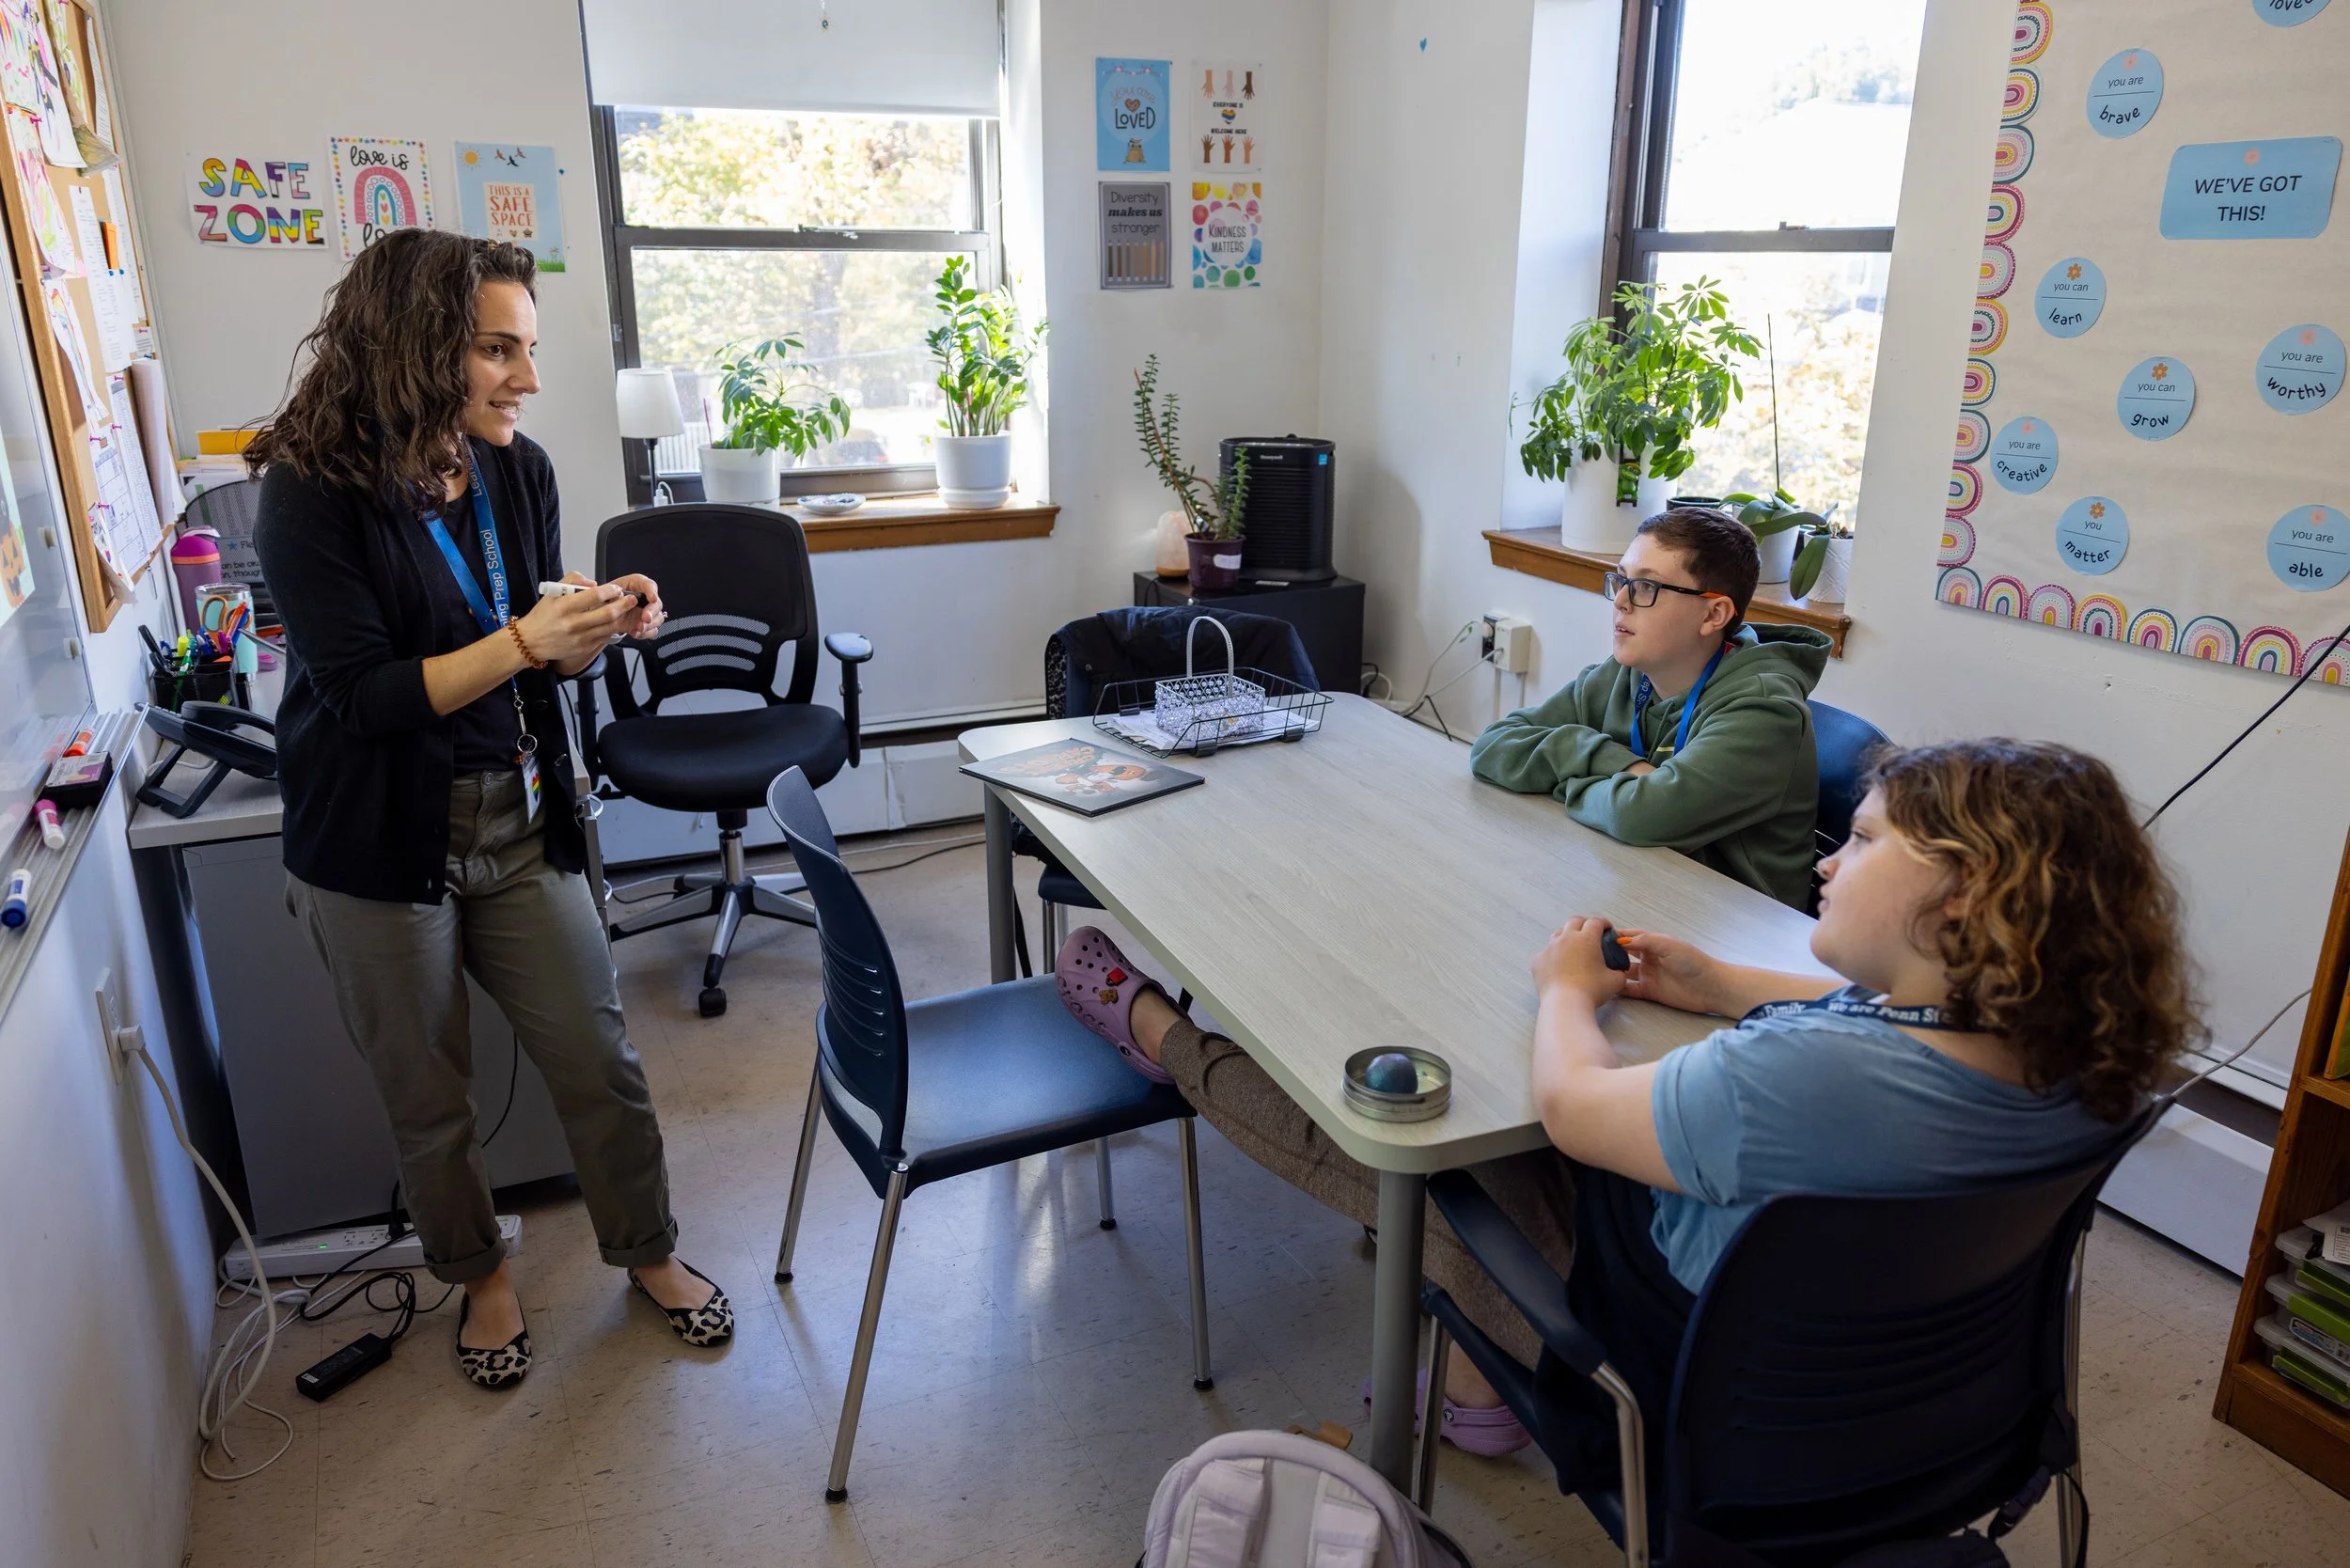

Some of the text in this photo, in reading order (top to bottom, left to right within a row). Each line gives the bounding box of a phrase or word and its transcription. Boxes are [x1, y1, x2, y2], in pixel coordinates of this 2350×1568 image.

[2269, 0, 2312, 10] ove
[2107, 75, 2144, 88] you are
[1115, 106, 1156, 130] LOVED
[2099, 105, 2140, 125] brave
[351, 146, 410, 170] love is
[198, 157, 310, 200] SAFE
[2260, 175, 2302, 193] GOT
[489, 184, 510, 196] THIS
[513, 187, 522, 196] IS
[490, 196, 534, 212] SAFE
[1110, 191, 1159, 206] Diversity
[491, 212, 534, 227] SPACE
[1108, 207, 1148, 216] makes
[2217, 205, 2265, 223] THIS!
[194, 203, 325, 244] ZONE
[1111, 222, 1159, 235] stronger
[363, 222, 385, 248] lo
[1212, 239, 1244, 253] MATTERS
[2053, 282, 2089, 294] you can
[2049, 307, 2082, 325] learn
[2281, 350, 2324, 364] you are
[2138, 383, 2175, 394] you can
[2266, 376, 2326, 401] worthy
[2130, 413, 2170, 428] grow
[2008, 440, 2025, 451] you
[1997, 460, 2047, 481] creative
[2084, 520, 2102, 530] you
[2291, 529, 2334, 543] you are
[480, 529, 498, 570] School
[2064, 541, 2110, 563] matter
[2288, 562, 2324, 578] able
[493, 572, 505, 601] Prep
[498, 603, 509, 627] ning
[1641, 680, 1650, 692] rep
[1849, 1004, 1876, 1014] are
[1877, 1006, 1920, 1022] Penn
